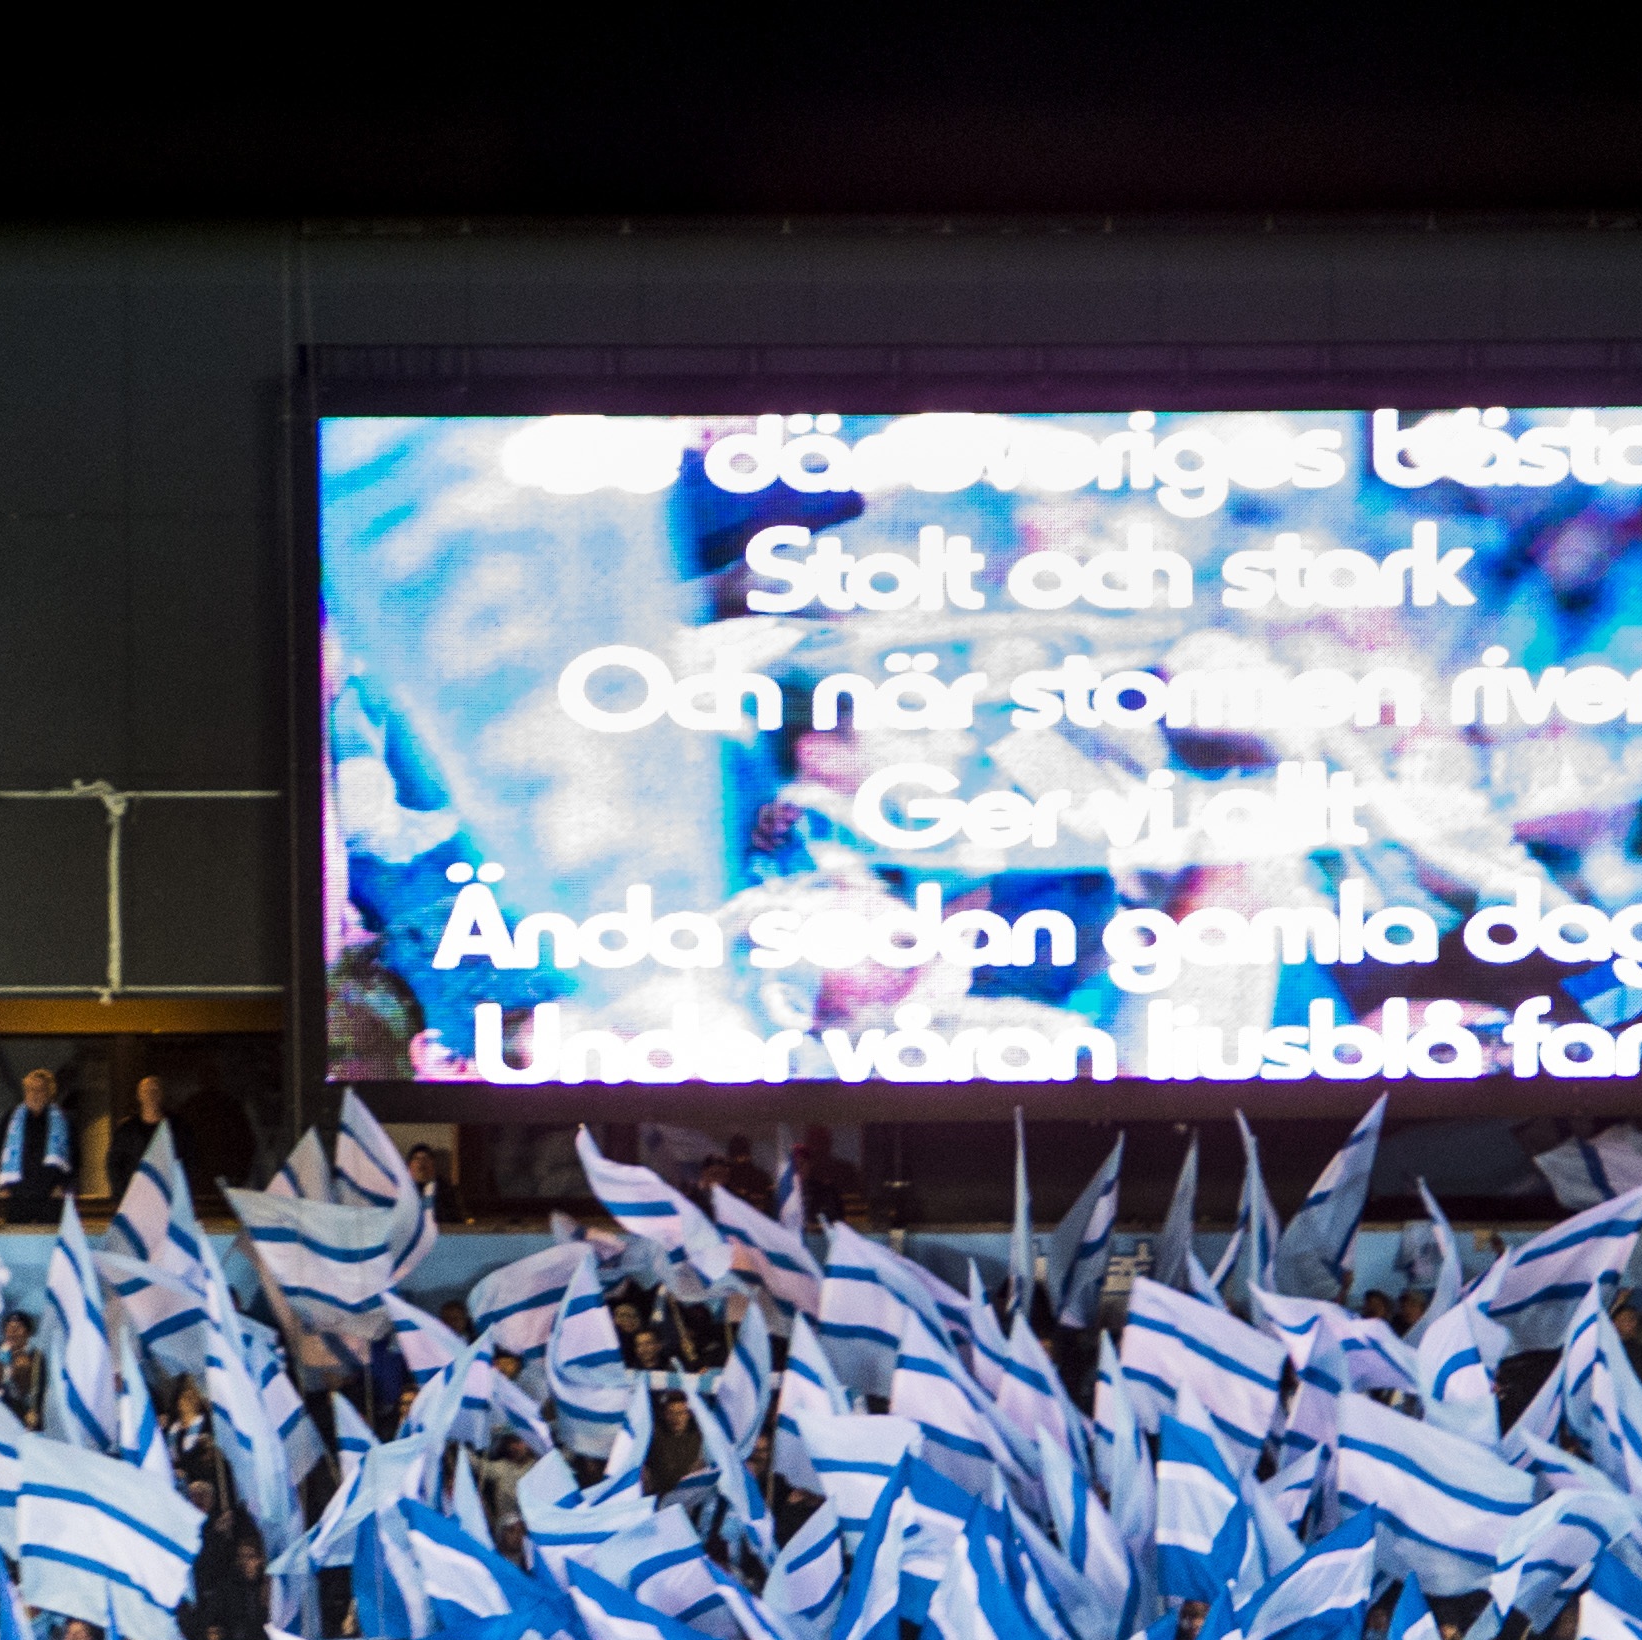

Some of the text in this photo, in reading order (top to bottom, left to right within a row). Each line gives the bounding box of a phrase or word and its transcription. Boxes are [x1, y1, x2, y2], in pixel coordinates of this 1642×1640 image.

[744, 519, 1479, 613] Stolt och stark
[556, 643, 784, 734] Och
[811, 651, 989, 731] när
[852, 761, 1073, 850] Ger
[430, 861, 725, 971] Ända
[747, 882, 1078, 969] sedan
[1100, 878, 1441, 994] gamla
[474, 1001, 805, 1085] Under
[820, 1003, 1119, 1084] våran
